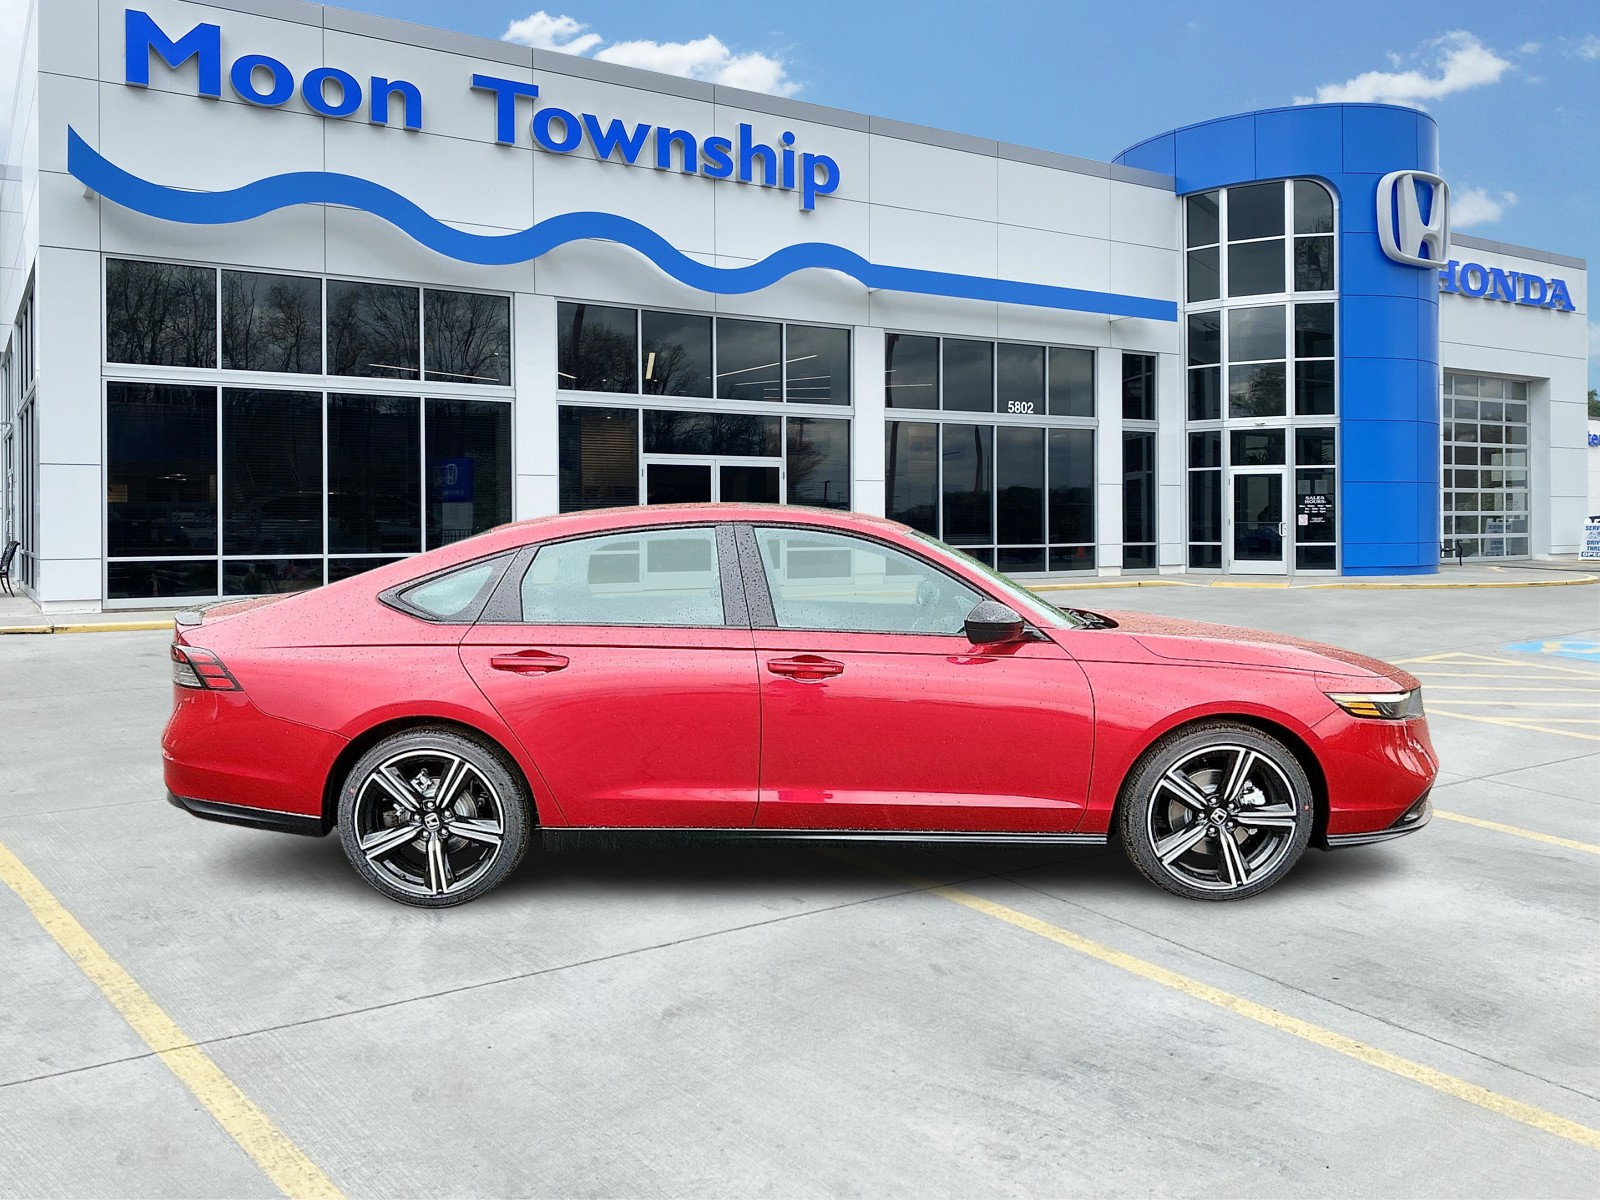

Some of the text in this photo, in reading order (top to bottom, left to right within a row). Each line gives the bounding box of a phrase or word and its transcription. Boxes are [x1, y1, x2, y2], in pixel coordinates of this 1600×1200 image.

[124, 8, 841, 213] Moon Township
[1007, 401, 1034, 413] 5802
